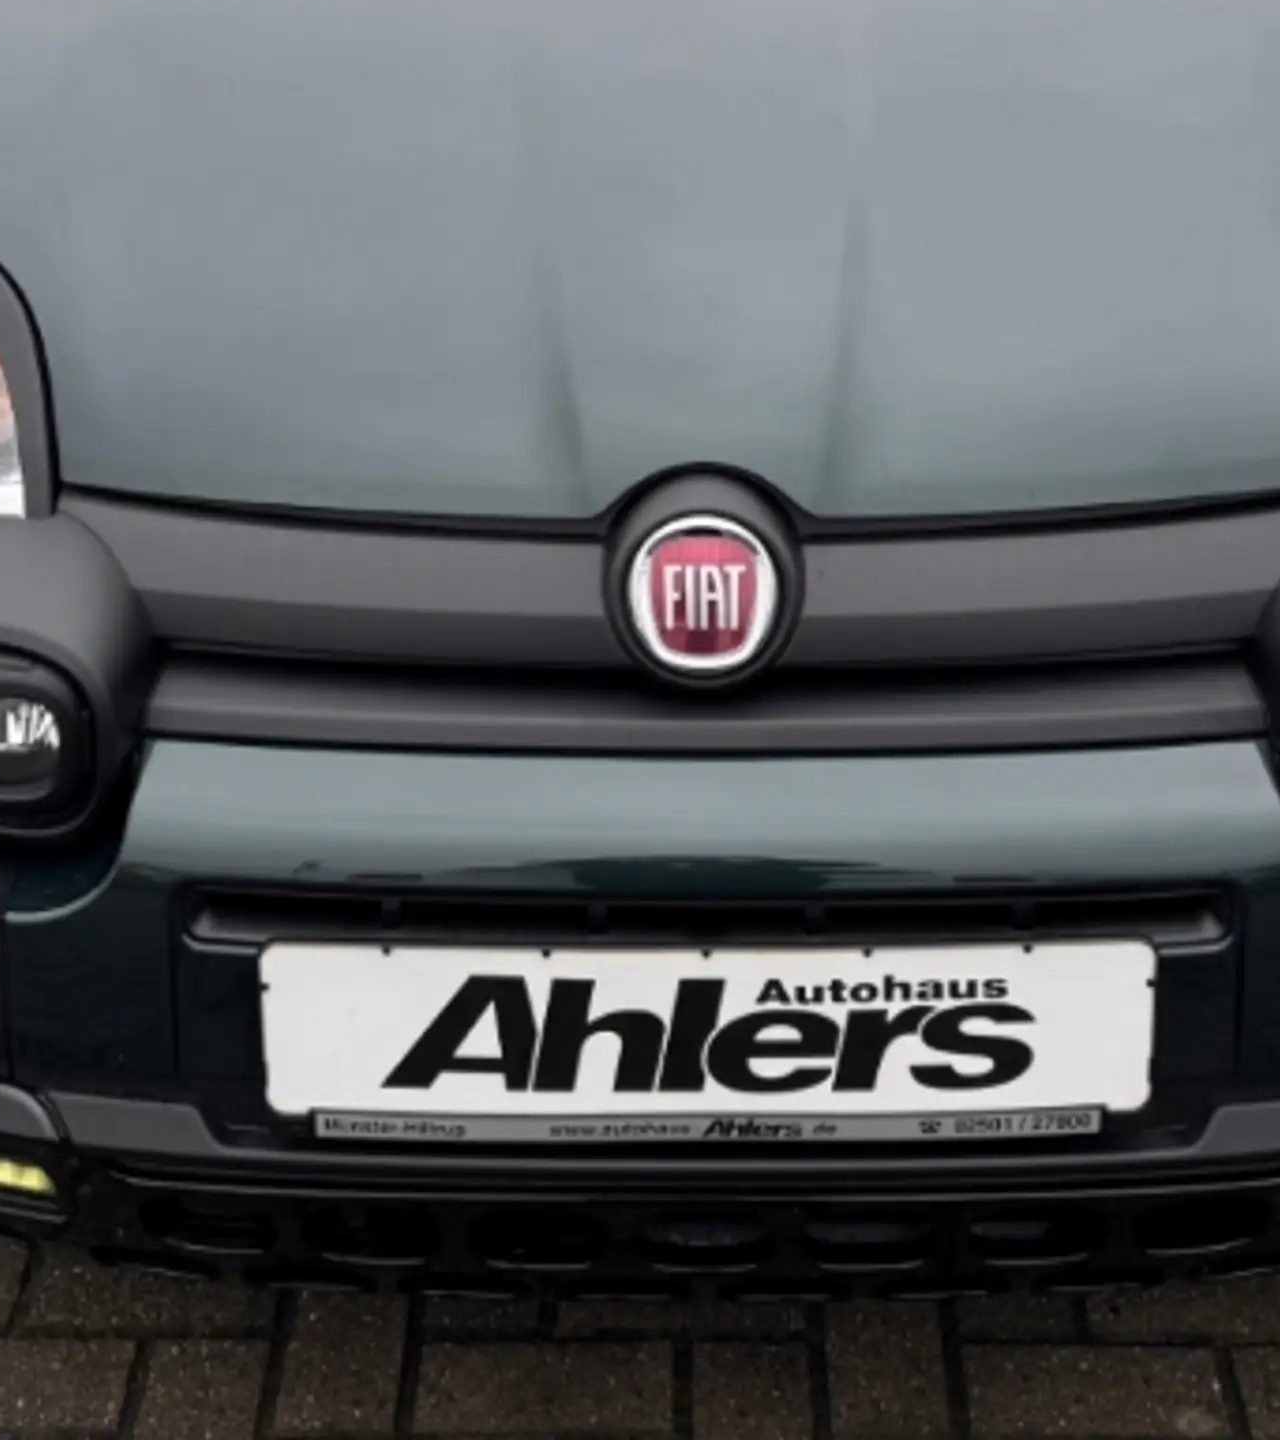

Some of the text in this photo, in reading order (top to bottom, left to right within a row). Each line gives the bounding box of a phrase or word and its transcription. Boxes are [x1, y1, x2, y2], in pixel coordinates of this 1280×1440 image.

[662, 564, 746, 631] FIAT
[755, 974, 1009, 1006] Autohaus
[381, 974, 1037, 1094] Ahlers
